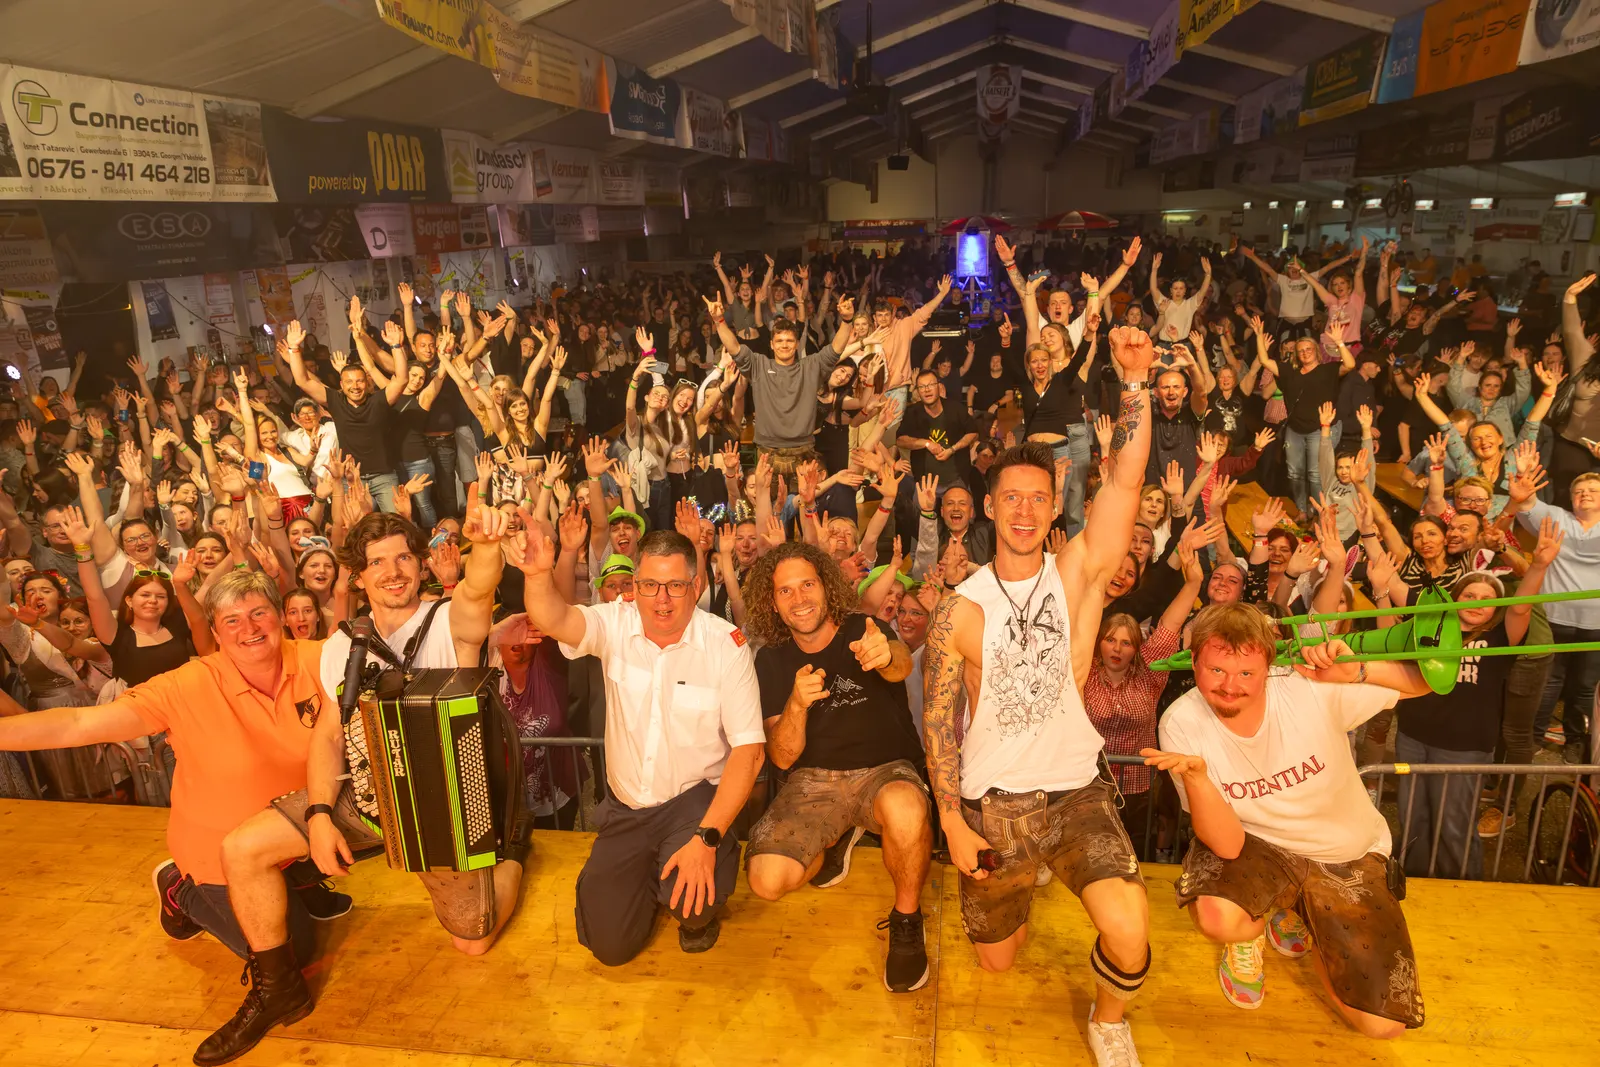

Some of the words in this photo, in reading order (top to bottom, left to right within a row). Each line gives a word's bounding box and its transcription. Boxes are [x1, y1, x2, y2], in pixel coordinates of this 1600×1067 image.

[69, 102, 199, 136] Connection
[40, 143, 75, 153] Tatarevic
[27, 157, 86, 179] 0676
[104, 161, 134, 181] 841
[140, 163, 179, 183] 464
[183, 166, 210, 184] 218
[477, 171, 514, 194] group
[308, 174, 351, 194] powered
[352, 173, 367, 194] by
[416, 217, 457, 239] Sorgen
[388, 730, 405, 777] RUTAR
[1221, 754, 1326, 800] POTENTIAL
